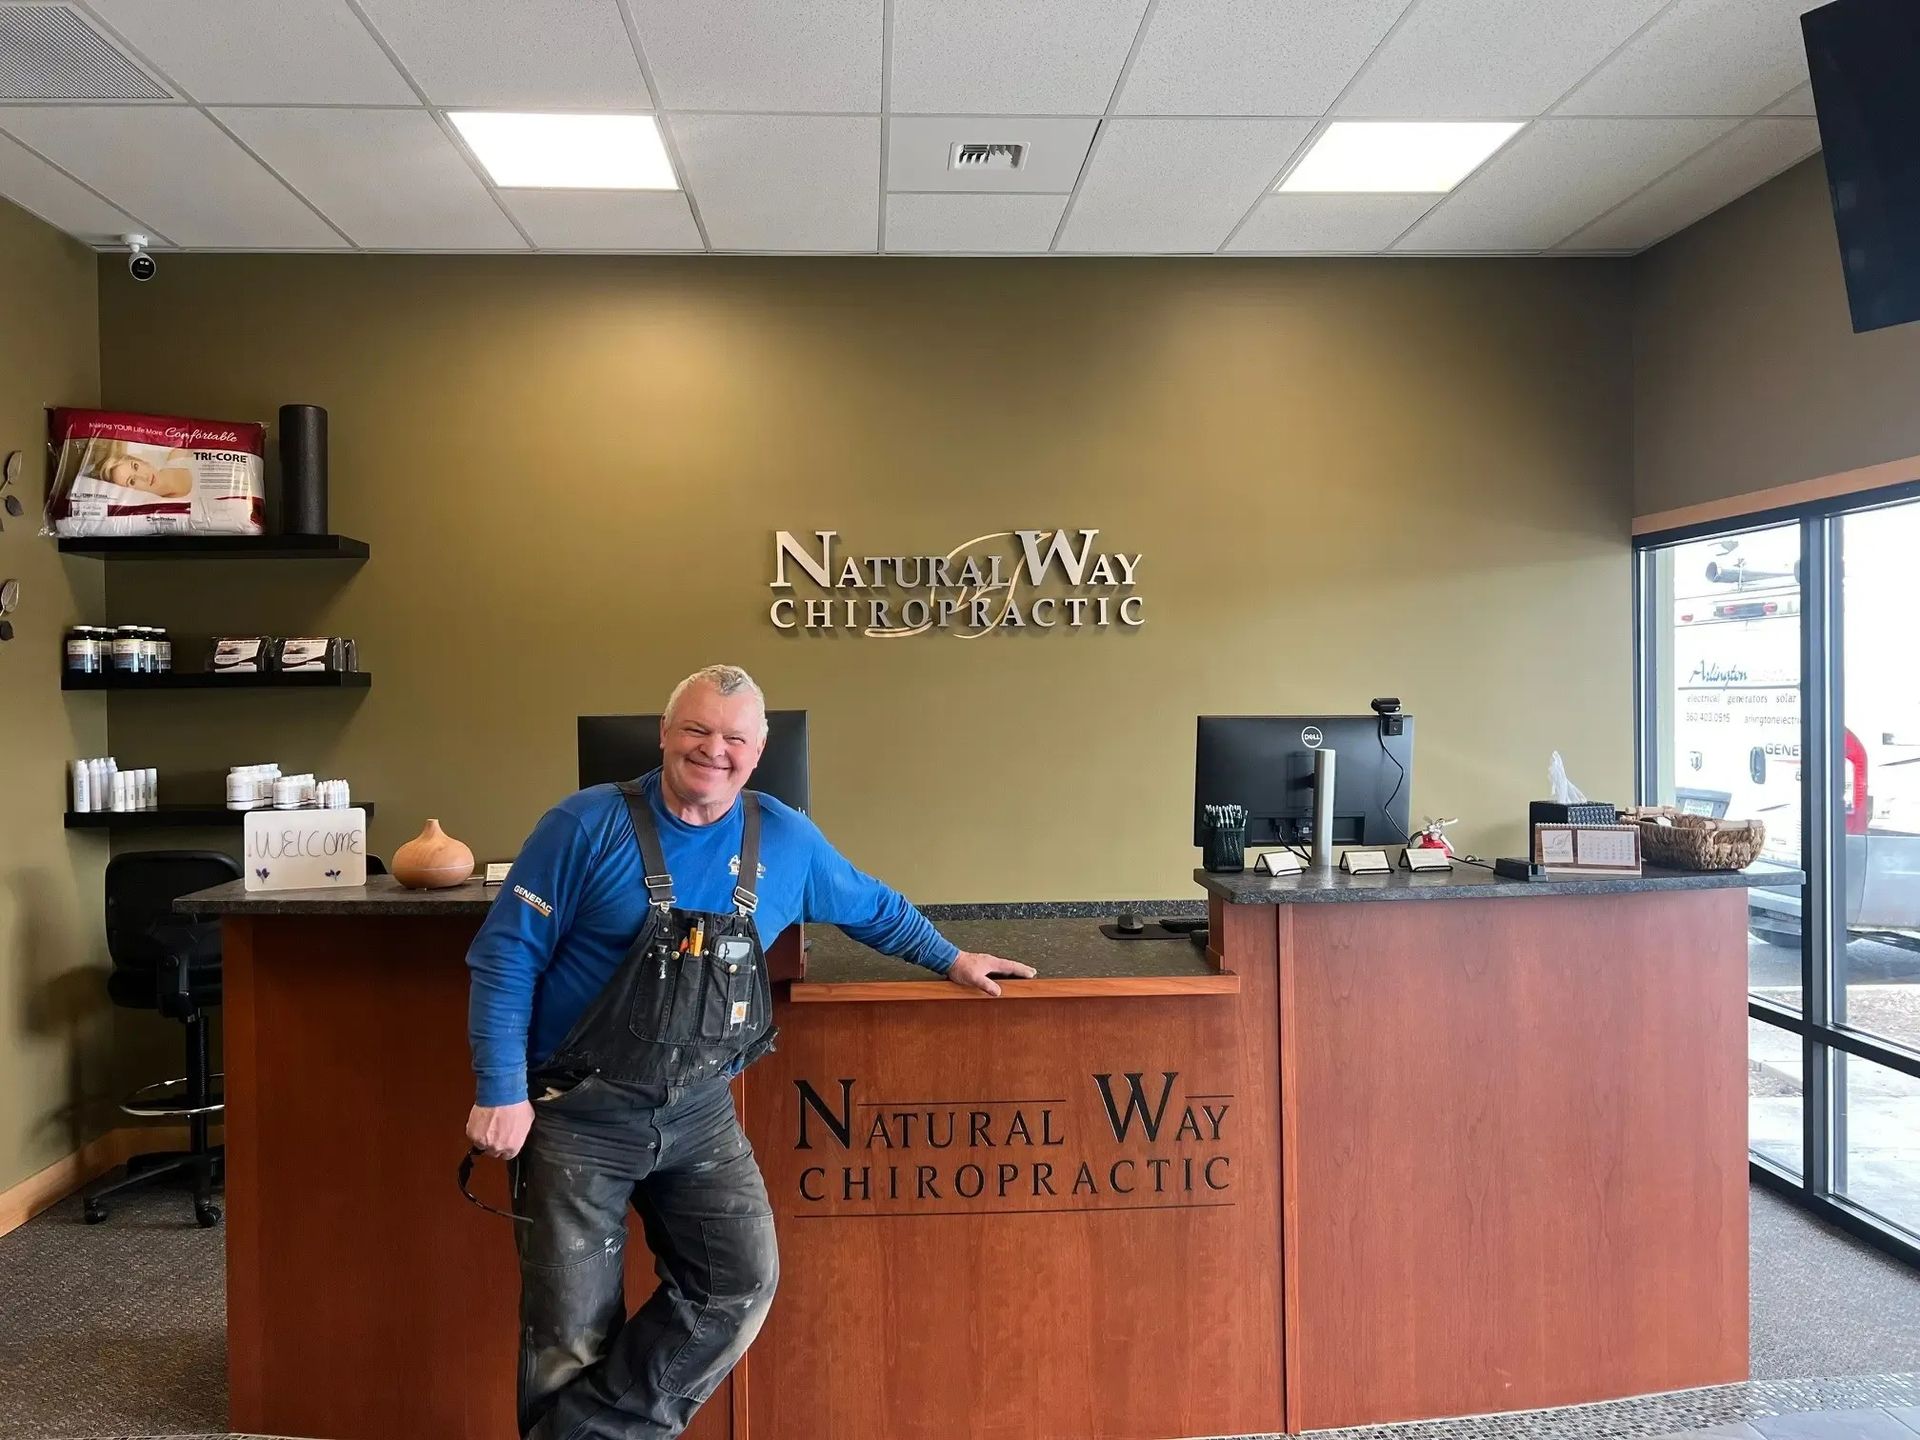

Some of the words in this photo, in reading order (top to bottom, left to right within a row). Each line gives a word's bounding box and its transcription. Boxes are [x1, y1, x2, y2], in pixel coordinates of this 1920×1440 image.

[113, 423, 133, 431] YOUR
[146, 428, 163, 436] More
[164, 426, 238, 443] Comfortable
[193, 452, 247, 463] TRI-CORE
[770, 597, 1145, 628] CHIROPRACTIC
[1689, 660, 1748, 691] Arlington
[1687, 694, 1720, 703] electrical
[1727, 694, 1768, 705] generators
[1776, 692, 1797, 703] solar
[1303, 733, 1321, 741] DELL
[1765, 743, 1800, 757] GENE
[513, 884, 554, 913] GENERAC
[799, 1156, 1230, 1200] CHIROPRACTIC
